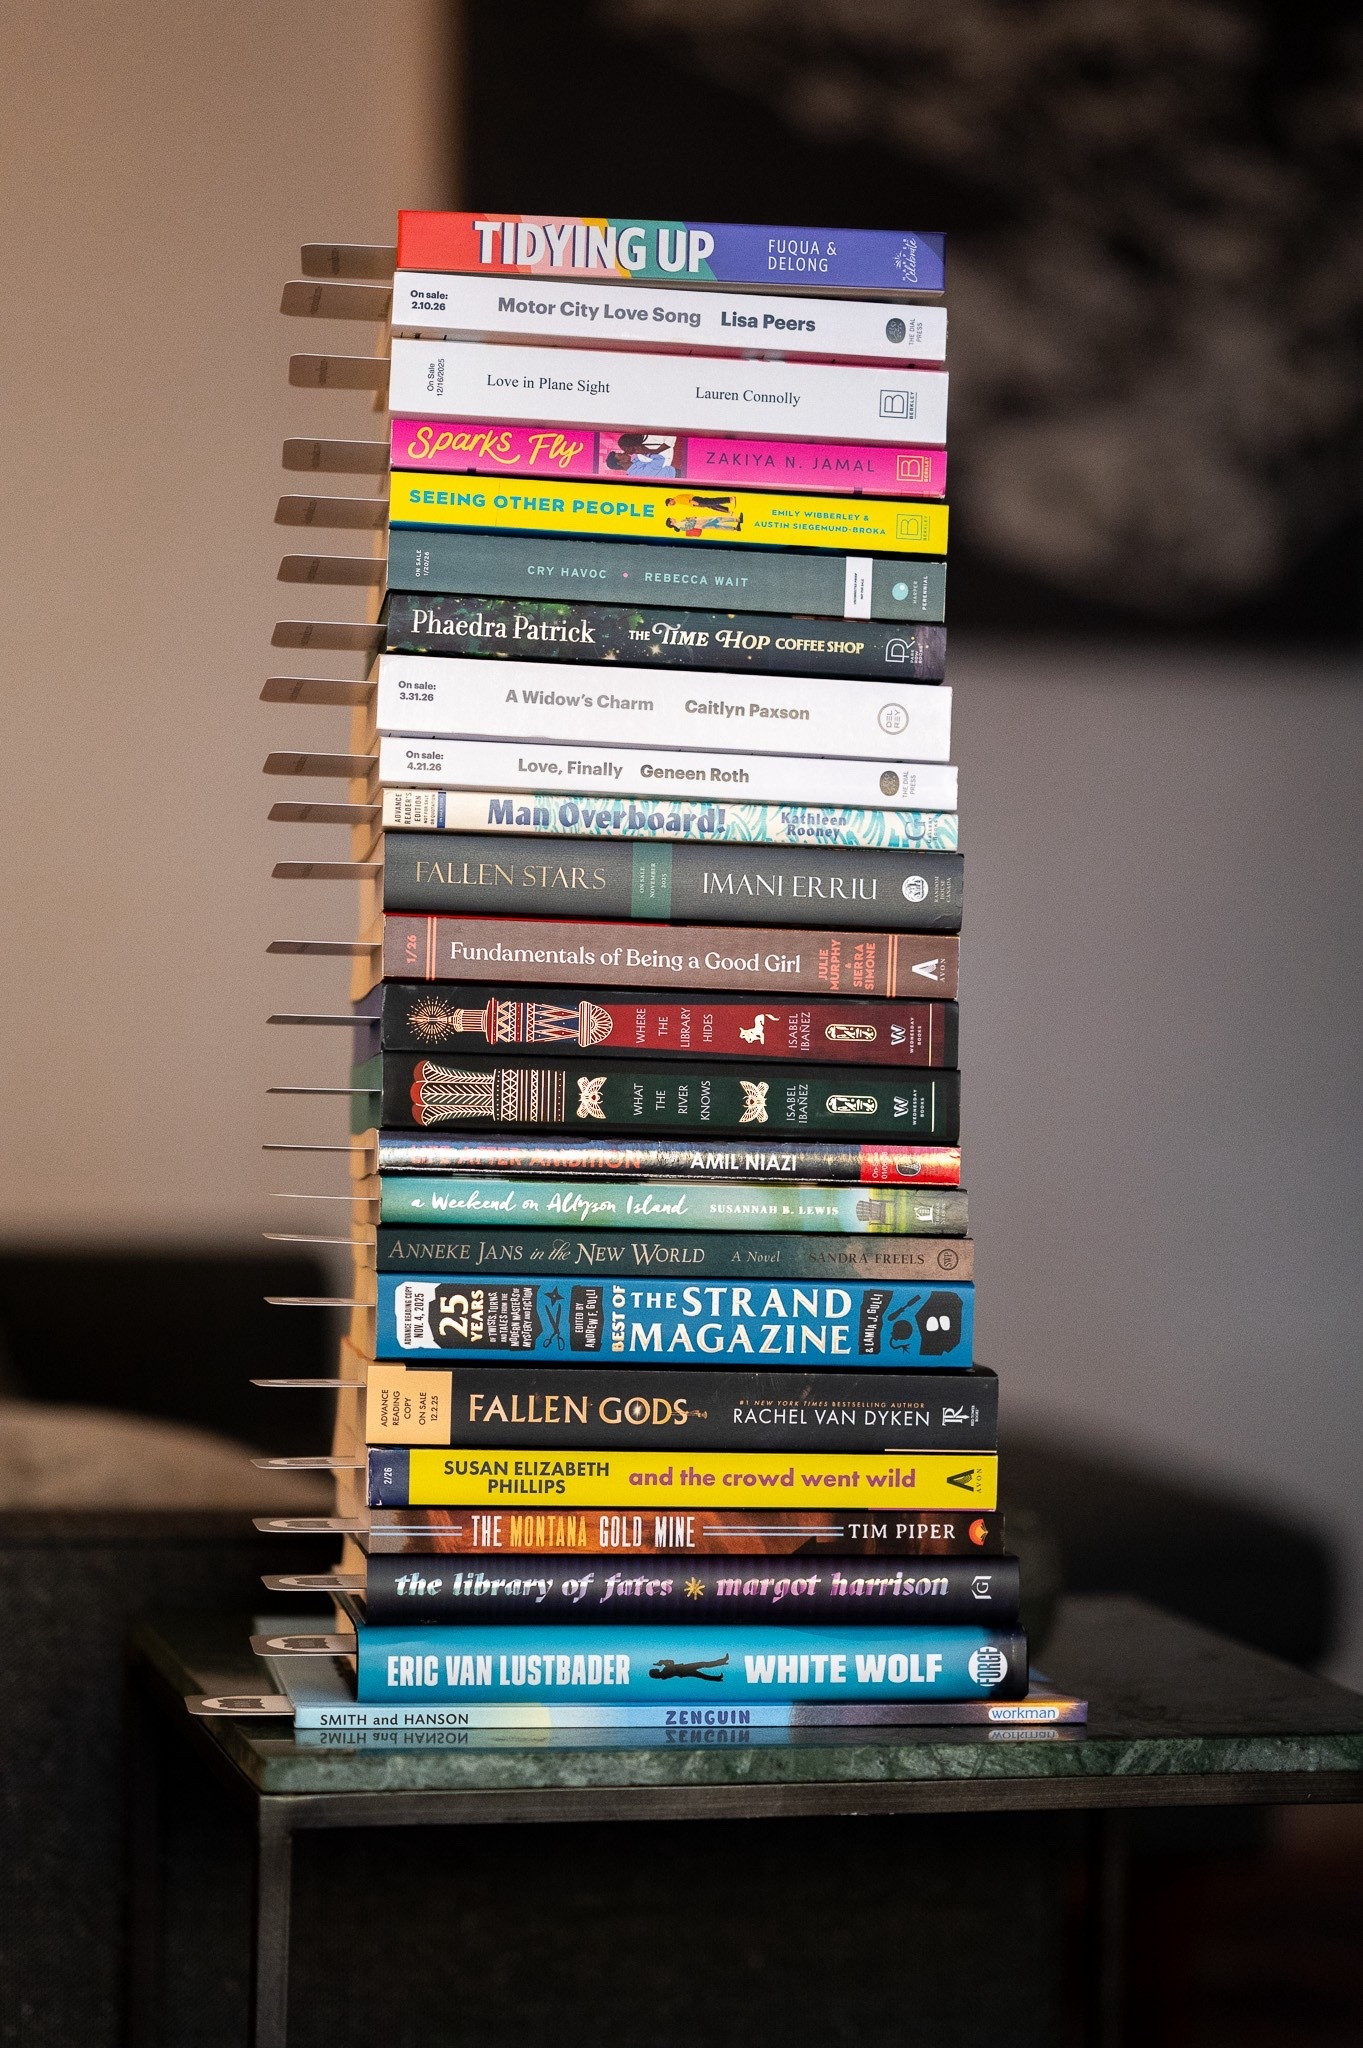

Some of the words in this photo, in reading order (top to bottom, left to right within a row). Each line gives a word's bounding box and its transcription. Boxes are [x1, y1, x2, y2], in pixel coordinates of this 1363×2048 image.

[473, 220, 647, 271] TIDYING
[656, 228, 715, 273] UP
[768, 239, 820, 256] FUQUA
[826, 241, 837, 255] &
[768, 256, 828, 272] DELONG
[410, 290, 424, 298] On
[426, 291, 448, 300] sale:
[411, 301, 446, 311] 2.10.26
[498, 297, 556, 314] Motor
[560, 301, 599, 321] City
[604, 304, 648, 321] Love
[652, 307, 701, 328] Song
[721, 311, 758, 328] Lisa
[763, 314, 816, 332] Peers
[487, 374, 519, 387] Love
[523, 376, 535, 389] in
[539, 377, 574, 391] Plane
[577, 380, 610, 396] Sight
[695, 387, 739, 401] Lauren
[743, 390, 801, 407] Connolly
[407, 426, 521, 465] Sparks
[528, 433, 584, 468] Fly
[706, 451, 776, 468] ZAKIYA
[785, 456, 802, 469] N.
[812, 457, 875, 472] JAMAL
[409, 489, 486, 508] SEEING
[493, 495, 565, 513] OTHER
[572, 499, 655, 518] PEOPLE
[527, 565, 555, 576] CRY
[561, 567, 607, 579] HAVOC
[645, 572, 708, 585] REBECCA
[714, 576, 749, 587] WAIT
[411, 609, 508, 638] Phaedra
[512, 615, 597, 644] Patrick
[629, 630, 650, 641] THE
[652, 622, 709, 647] TIME
[714, 629, 771, 650] HOP
[775, 637, 825, 652] COFFEE
[827, 640, 865, 655] SHOP
[398, 680, 413, 689] On
[414, 681, 437, 690] sale:
[399, 692, 434, 701] 3.31.26
[505, 689, 519, 703] A
[522, 690, 593, 707] Widow's
[597, 694, 654, 711] Charm
[684, 699, 746, 719] Caitlyn
[749, 703, 811, 721] Paxson
[405, 750, 420, 759] On
[421, 751, 444, 760] sale:
[406, 762, 442, 771] 4.21.26
[518, 758, 564, 775] Love,
[567, 760, 623, 779] Finally
[640, 764, 706, 781] Geneen
[710, 767, 750, 783] Roth
[487, 799, 550, 826] Man
[558, 801, 726, 834] Overboard!
[781, 812, 847, 827] Kathleen
[787, 824, 840, 841] Rooney
[416, 861, 514, 886] FALLEN
[523, 865, 606, 890] STARS
[703, 872, 783, 897] IMANI
[792, 875, 878, 900] ERRIU
[450, 942, 596, 965] Fundamentals
[600, 948, 623, 966] of
[626, 950, 684, 971] Being
[688, 955, 700, 969] a
[704, 952, 760, 972] Good
[764, 954, 801, 974] Girl
[818, 949, 829, 980] JULIE
[830, 939, 842, 991] MURPHY
[853, 943, 864, 987] SIERRA
[865, 942, 876, 991] SIMONE
[635, 1008, 647, 1044] WHERE
[658, 1015, 668, 1037] THE
[680, 1007, 691, 1049] LIBRARY
[702, 1013, 713, 1043] HIDES
[788, 1013, 799, 1049] ISABEL
[800, 1011, 811, 1051] IBAÑEZ
[633, 1082, 644, 1117] WHAT
[655, 1089, 666, 1110] THE
[677, 1084, 689, 1115] RIVER
[700, 1080, 711, 1121] KNOWS
[786, 1085, 796, 1121] ISABEL
[798, 1083, 809, 1124] IBAÑEZ
[690, 1153, 738, 1170] AMIL
[745, 1154, 797, 1172] NIAZI
[411, 1199, 425, 1208] a
[432, 1190, 517, 1212] Weekend
[522, 1200, 539, 1212] on
[546, 1192, 616, 1222] Allyson
[626, 1193, 688, 1216] Island
[710, 1204, 778, 1214] SUSANNAH
[782, 1205, 795, 1215] B.
[798, 1206, 839, 1216] LEWIS
[388, 1240, 471, 1260] ANNEKE
[475, 1241, 523, 1266] JANS
[530, 1245, 546, 1261] in
[548, 1238, 571, 1261] the
[575, 1242, 625, 1266] NEW
[631, 1243, 705, 1266] WORLD
[808, 1252, 868, 1264] SANDRA
[875, 1253, 925, 1265] FREELS
[612, 1284, 626, 1308] OF
[630, 1291, 677, 1309] THE
[681, 1286, 852, 1319] STRAND
[439, 1294, 469, 1338] 25
[470, 1289, 484, 1343] YEARS
[611, 1311, 626, 1353] BEST
[629, 1322, 852, 1355] MAGAZINE
[381, 1389, 389, 1427] ADVANCE
[392, 1390, 400, 1426] READING
[418, 1392, 427, 1411] SALE
[430, 1395, 438, 1421] 12.2.25
[468, 1394, 589, 1424] FALLEN
[598, 1397, 689, 1426] GODS
[418, 1413, 427, 1426] ON
[733, 1408, 808, 1425] RACHEL
[814, 1409, 856, 1426] VAN
[864, 1410, 930, 1427] DYKEN
[443, 1460, 508, 1476] SUSAN
[514, 1461, 610, 1477] ELIZABETH
[629, 1466, 673, 1486] and
[680, 1467, 716, 1487] the
[722, 1467, 795, 1488] crowd
[801, 1470, 860, 1488] went
[866, 1468, 916, 1488] wild
[487, 1479, 566, 1494] PHILLIPS
[471, 1515, 502, 1547] THE
[509, 1515, 587, 1547] MONTANA
[599, 1516, 642, 1548] GOLD
[654, 1516, 695, 1548] MINE
[848, 1523, 888, 1539] TIM
[895, 1524, 955, 1539] PIPER
[395, 1572, 443, 1596] the
[452, 1572, 554, 1603] library
[561, 1572, 595, 1604] of
[599, 1573, 675, 1604] fates
[716, 1574, 822, 1604] margot
[829, 1571, 950, 1597] harrison
[387, 1655, 438, 1686] ERIC
[445, 1655, 492, 1686] VAN
[499, 1654, 630, 1685] LUSTBADER
[744, 1654, 846, 1684] WHITE
[855, 1653, 943, 1684] WOLF
[319, 1714, 367, 1726] SMITH
[373, 1713, 398, 1726] and
[404, 1713, 469, 1726] HANSON
[665, 1710, 751, 1725] ZENGUIN
[992, 1708, 1056, 1720] workman
